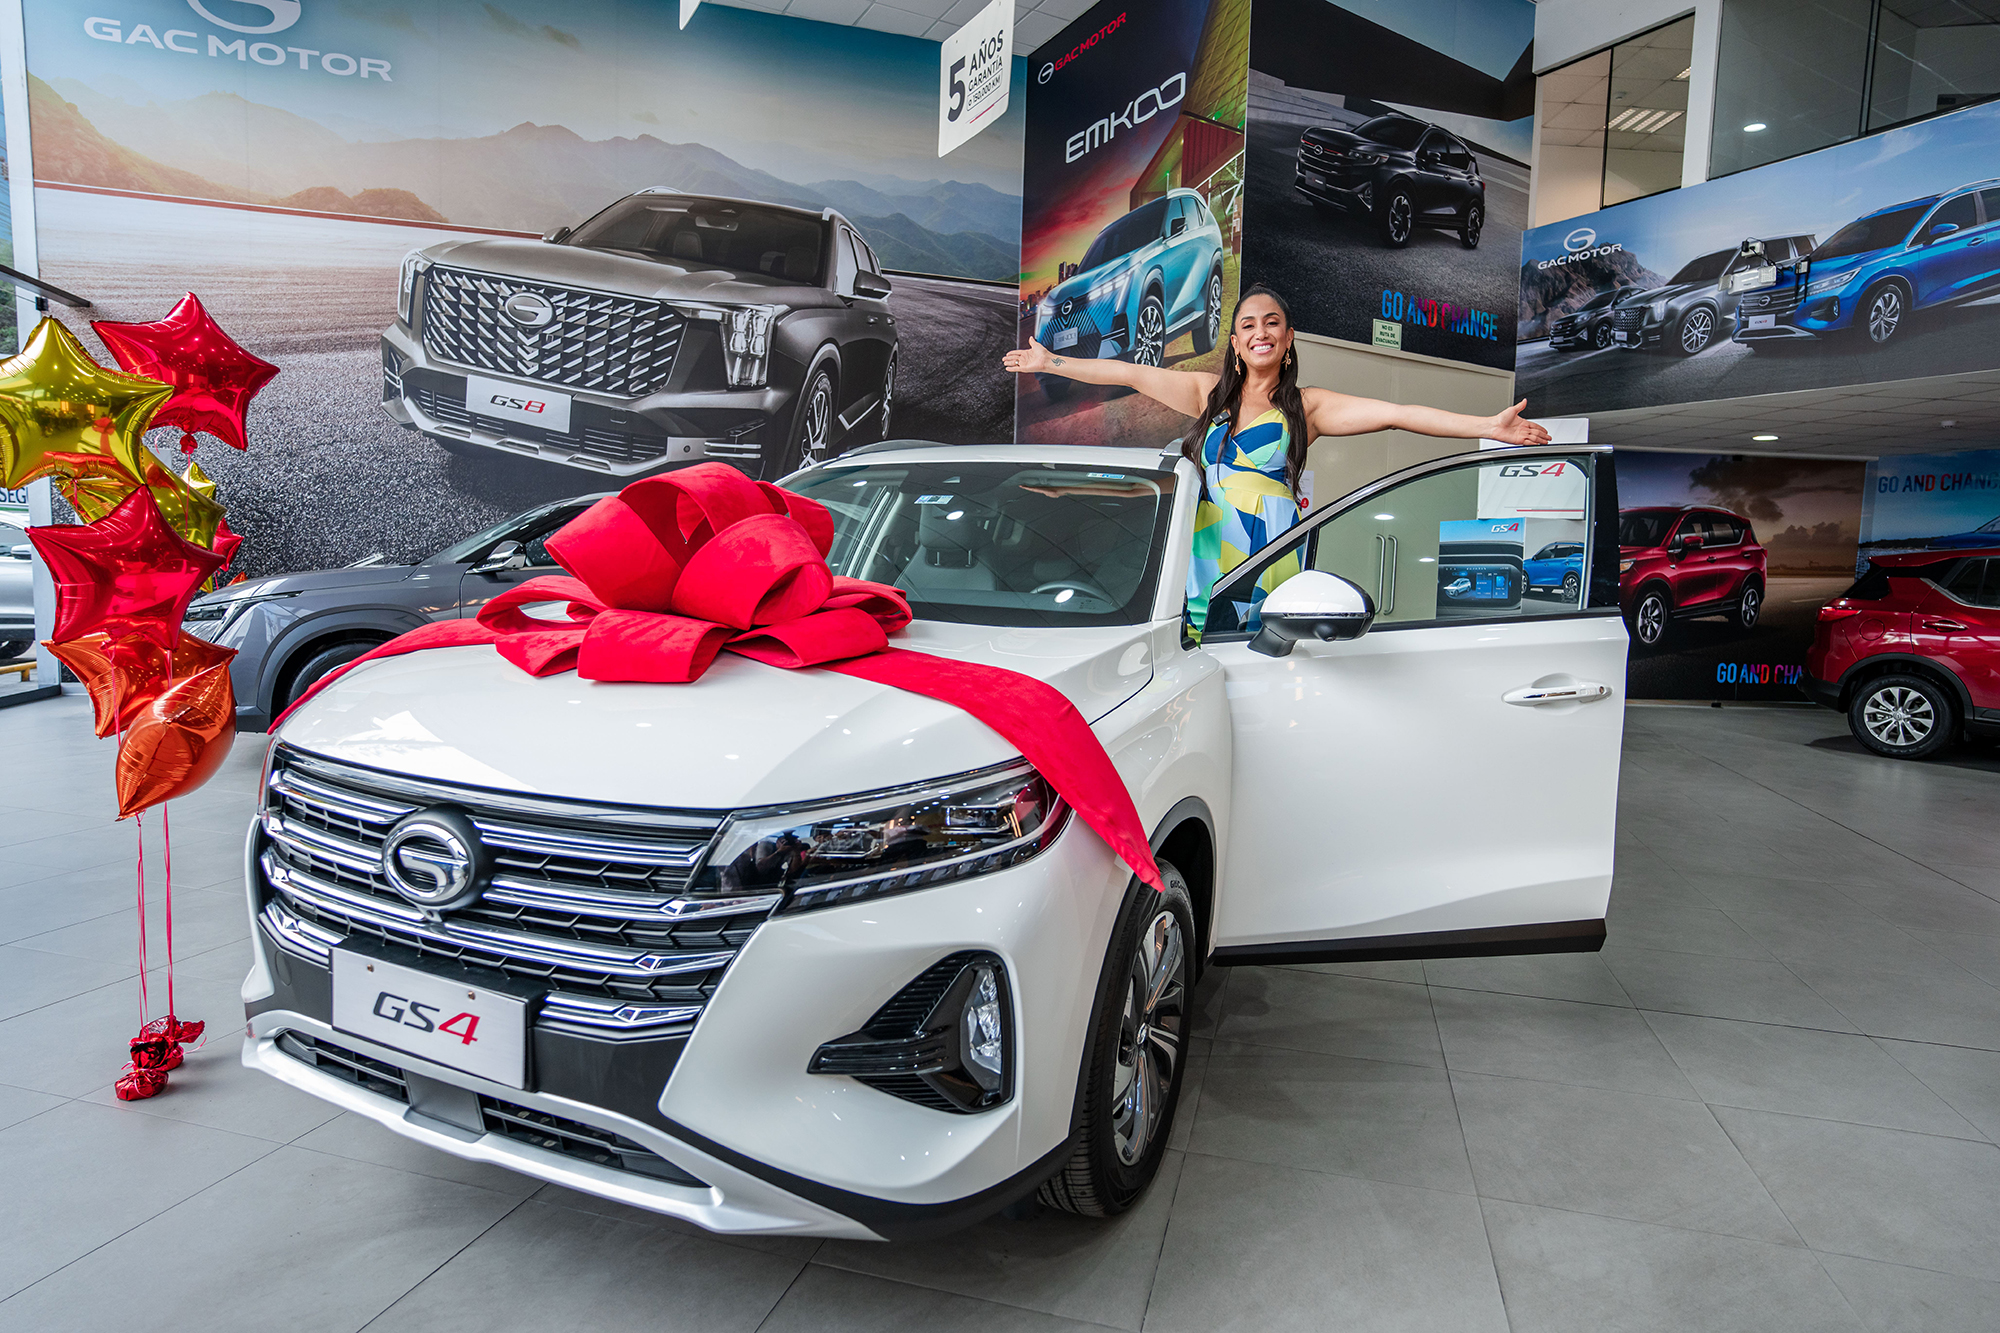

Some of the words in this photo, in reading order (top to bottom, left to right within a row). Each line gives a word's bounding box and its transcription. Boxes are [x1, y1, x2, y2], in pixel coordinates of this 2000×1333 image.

[83, 16, 198, 54] GAC
[207, 34, 393, 82] MOTOR
[968, 29, 1004, 76] AÑOS
[1055, 46, 1079, 71] GAC
[1080, 12, 1127, 54] MOTOR
[947, 55, 966, 122] 5
[1537, 256, 1567, 270] GAC
[1568, 243, 1622, 263] MOTOR
[1381, 289, 1403, 321] GO
[1406, 295, 1438, 328] AND
[1441, 303, 1499, 341] CHANGE
[490, 394, 546, 414] GS8
[1499, 463, 1566, 477] GS4
[1878, 475, 1900, 494] GO
[1902, 474, 1936, 493] AND
[1940, 472, 2000, 492] CHANG
[0, 486, 29, 504] SEG
[1491, 522, 1519, 534] GS4
[1716, 662, 1738, 684] GO
[1739, 663, 1770, 684] AND
[373, 991, 481, 1046] GS4
